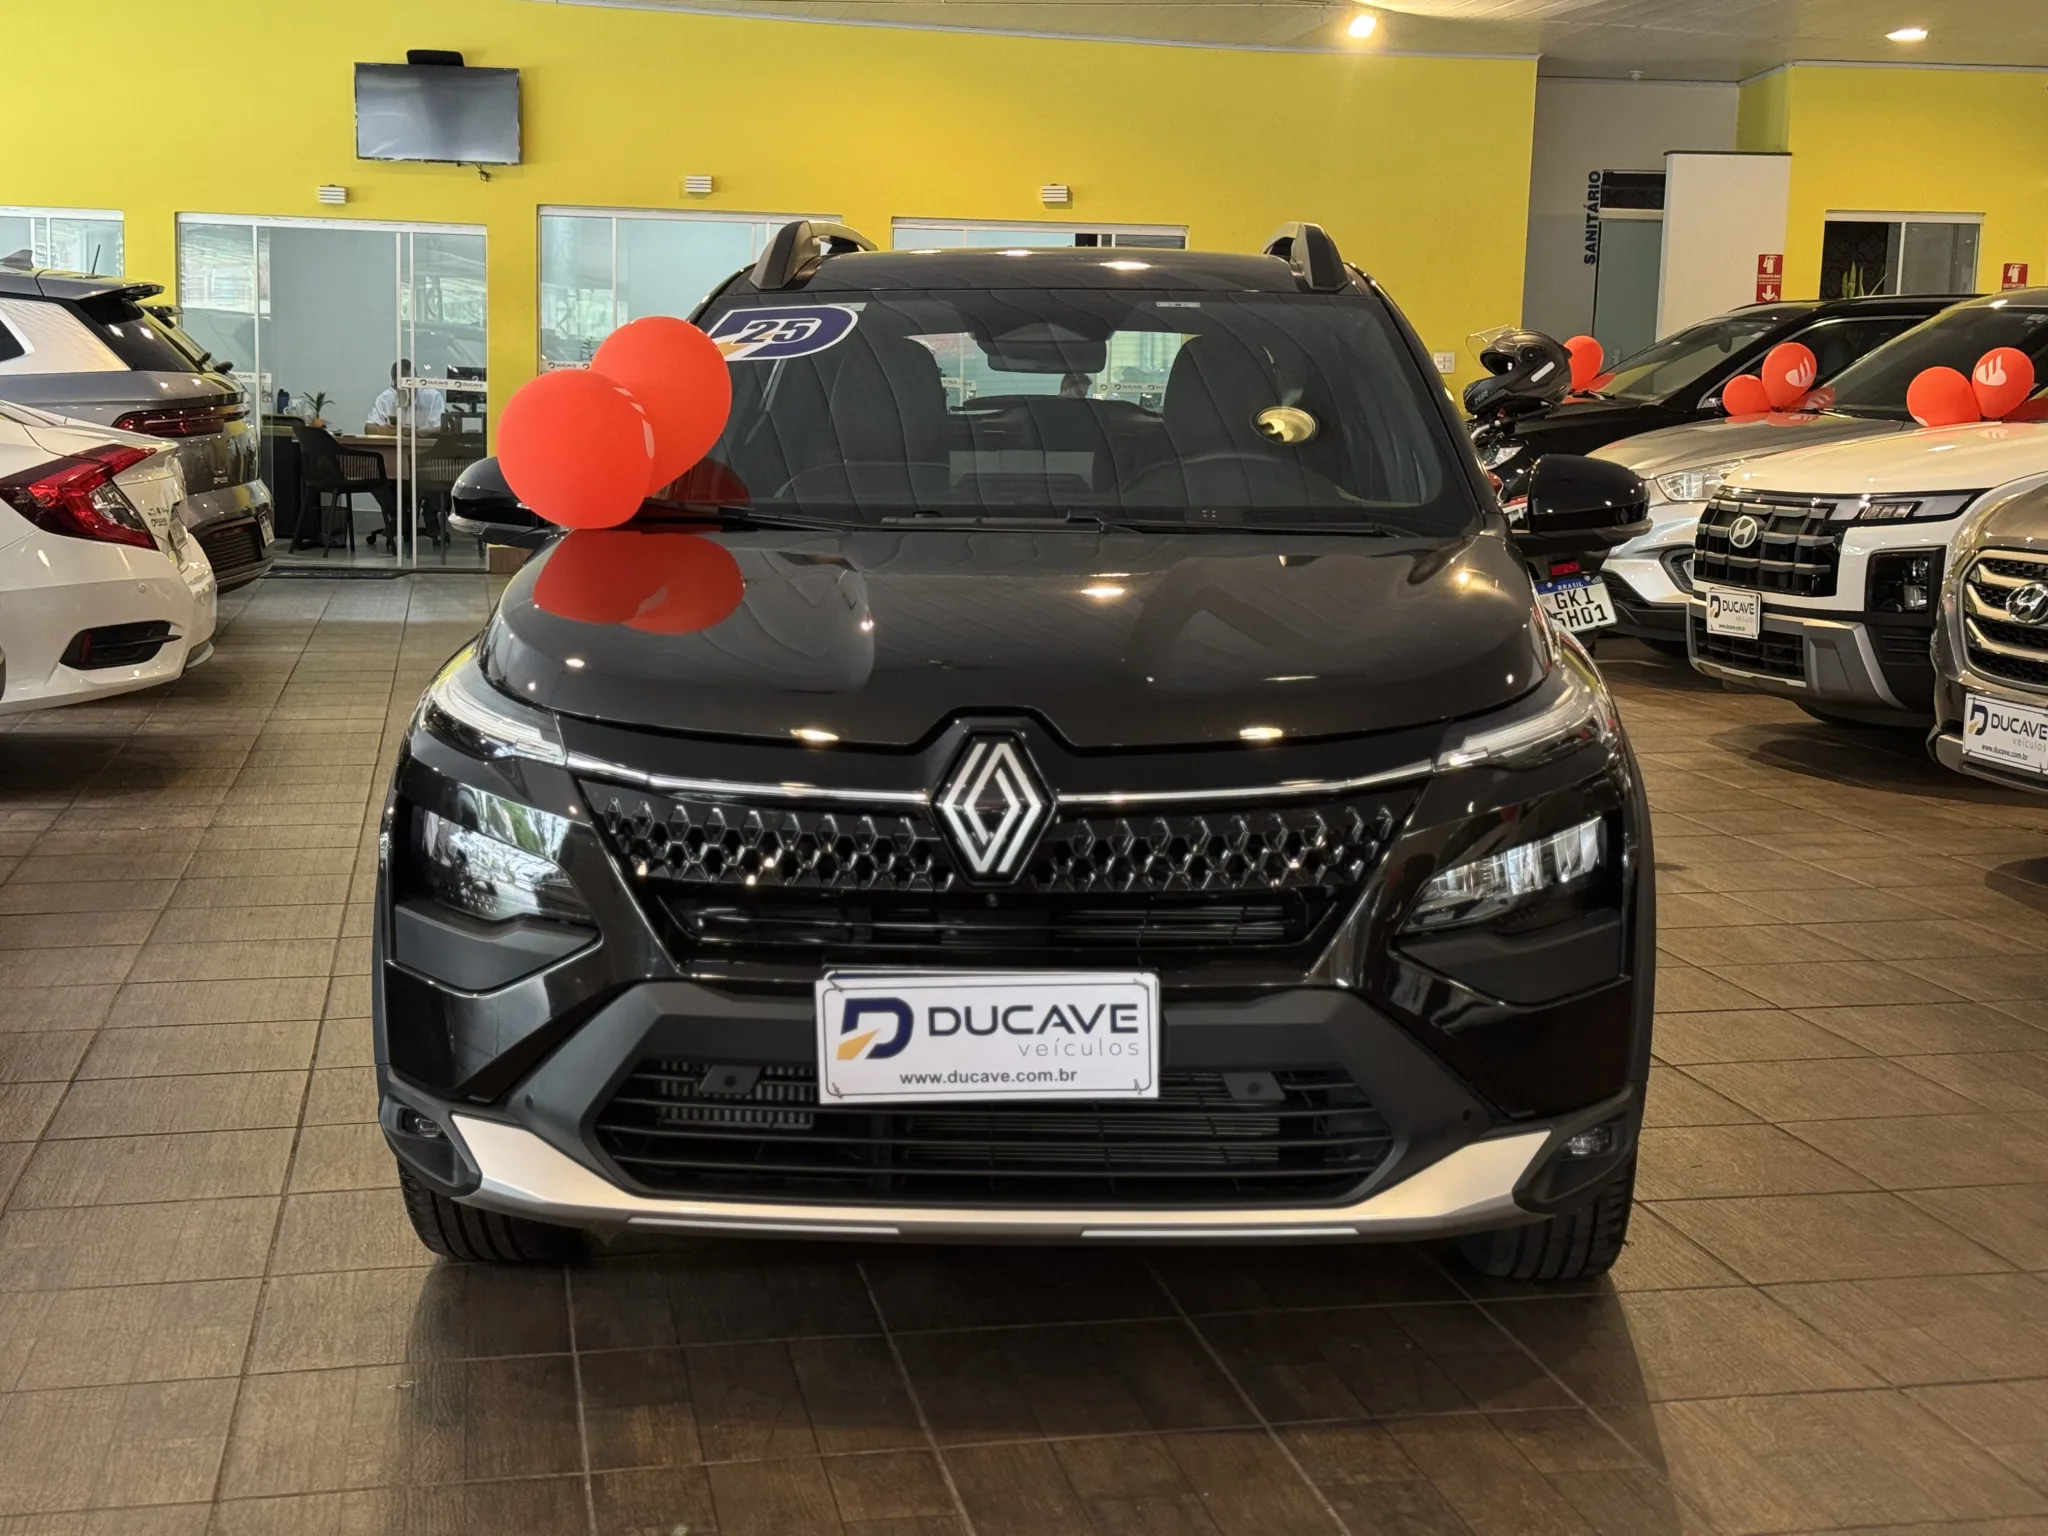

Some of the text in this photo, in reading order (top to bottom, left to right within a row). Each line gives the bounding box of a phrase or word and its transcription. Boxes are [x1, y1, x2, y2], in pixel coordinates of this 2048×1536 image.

[1583, 170, 1601, 265] SANITÁRIO
[733, 319, 817, 344] 25
[1557, 581, 1584, 591] BRASIL
[1554, 588, 1594, 610] GKI
[1722, 600, 1755, 615] DUCAVE
[1991, 713, 2048, 741] DUCAVE
[1981, 744, 2029, 761] www.ducave.com.br
[2012, 736, 2047, 753] veículos
[928, 1003, 1138, 1037] DUCAVE
[1017, 1038, 1139, 1058] veículos
[899, 1068, 1078, 1085] www.ducave.com.br
